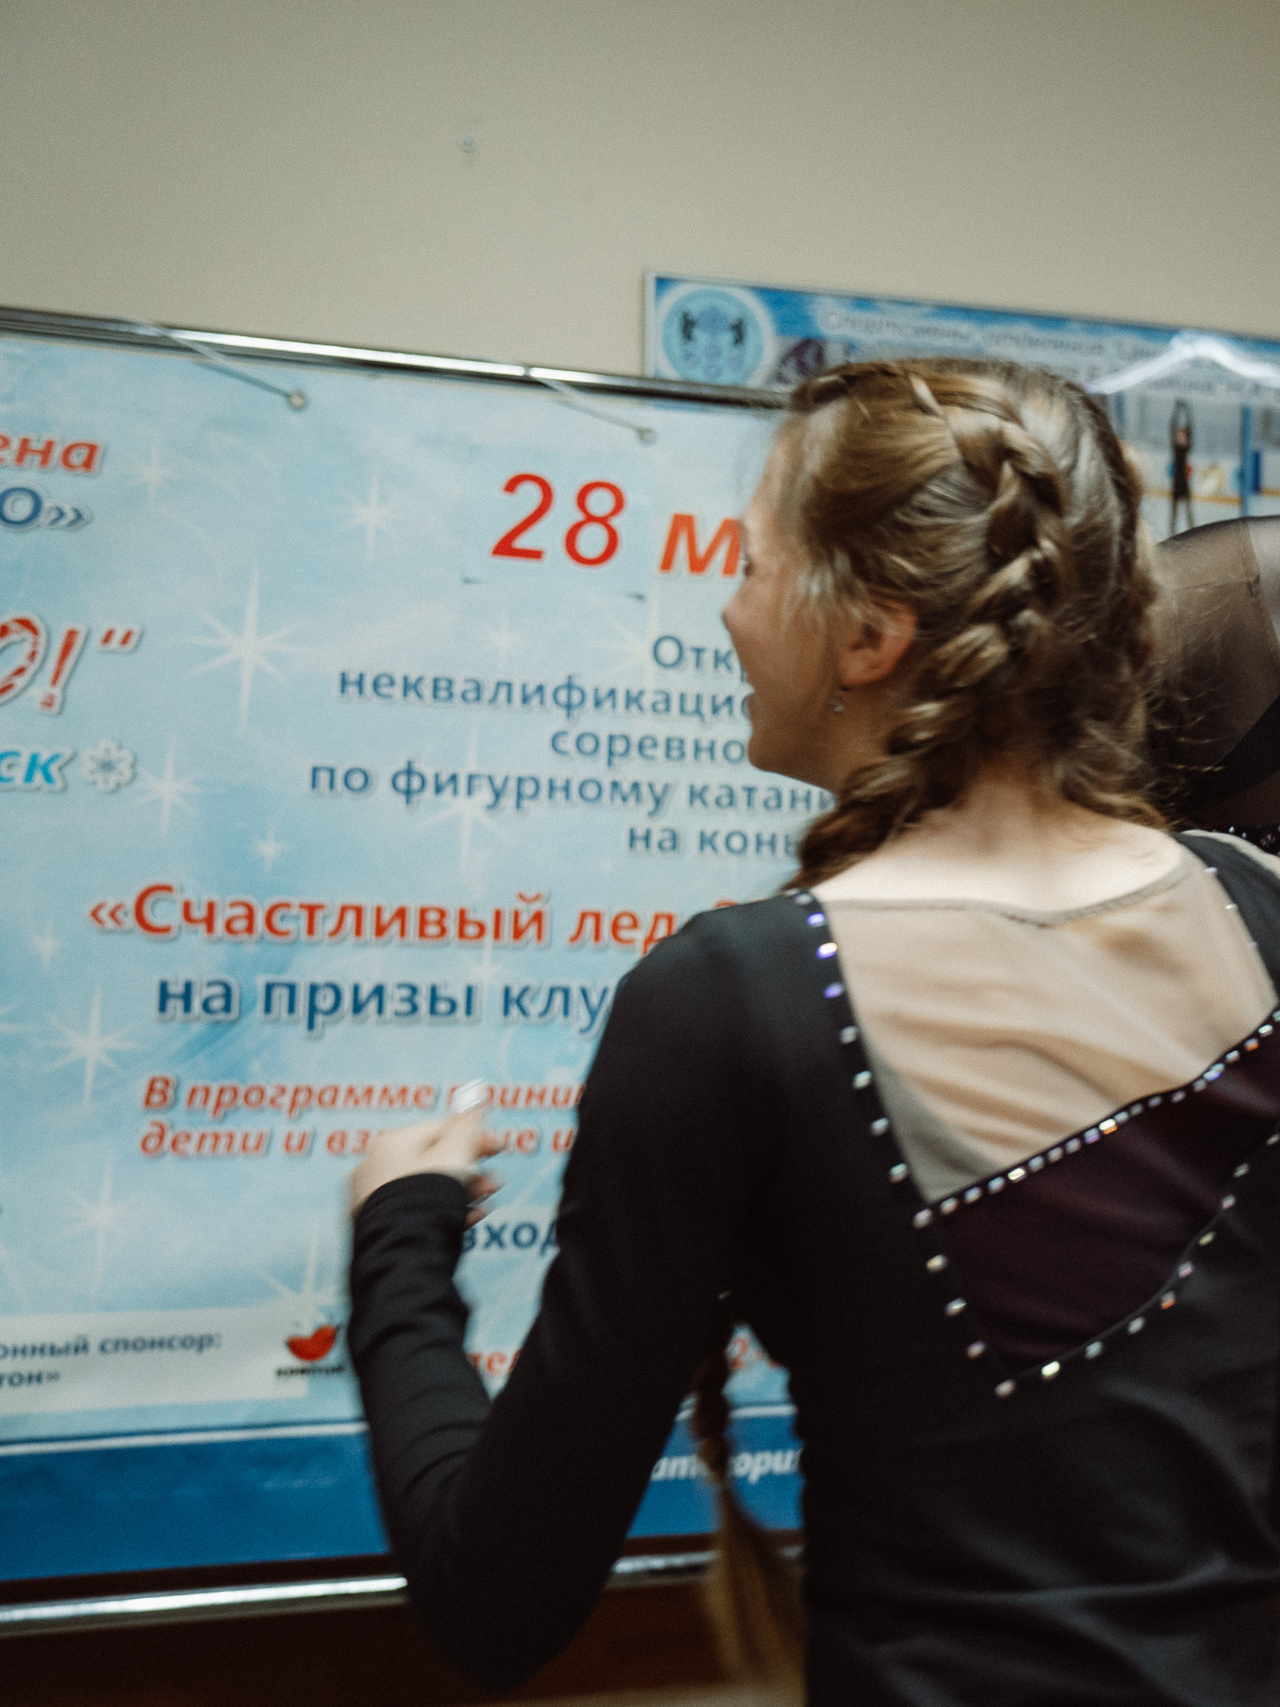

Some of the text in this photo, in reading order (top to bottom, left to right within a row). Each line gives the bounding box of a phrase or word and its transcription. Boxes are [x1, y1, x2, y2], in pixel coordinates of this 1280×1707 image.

[491, 472, 627, 567] 28
[338, 669, 749, 722] неквалификаци
[551, 729, 746, 766] соревно
[310, 765, 371, 794] по
[391, 761, 670, 815] фигурному
[628, 825, 679, 853] на
[89, 884, 546, 945] «Счастливый
[157, 978, 614, 1034] на призы клу
[142, 1076, 172, 1110] В
[186, 1082, 437, 1119] программе
[139, 1121, 266, 1156] дети
[284, 1128, 309, 1154] и
